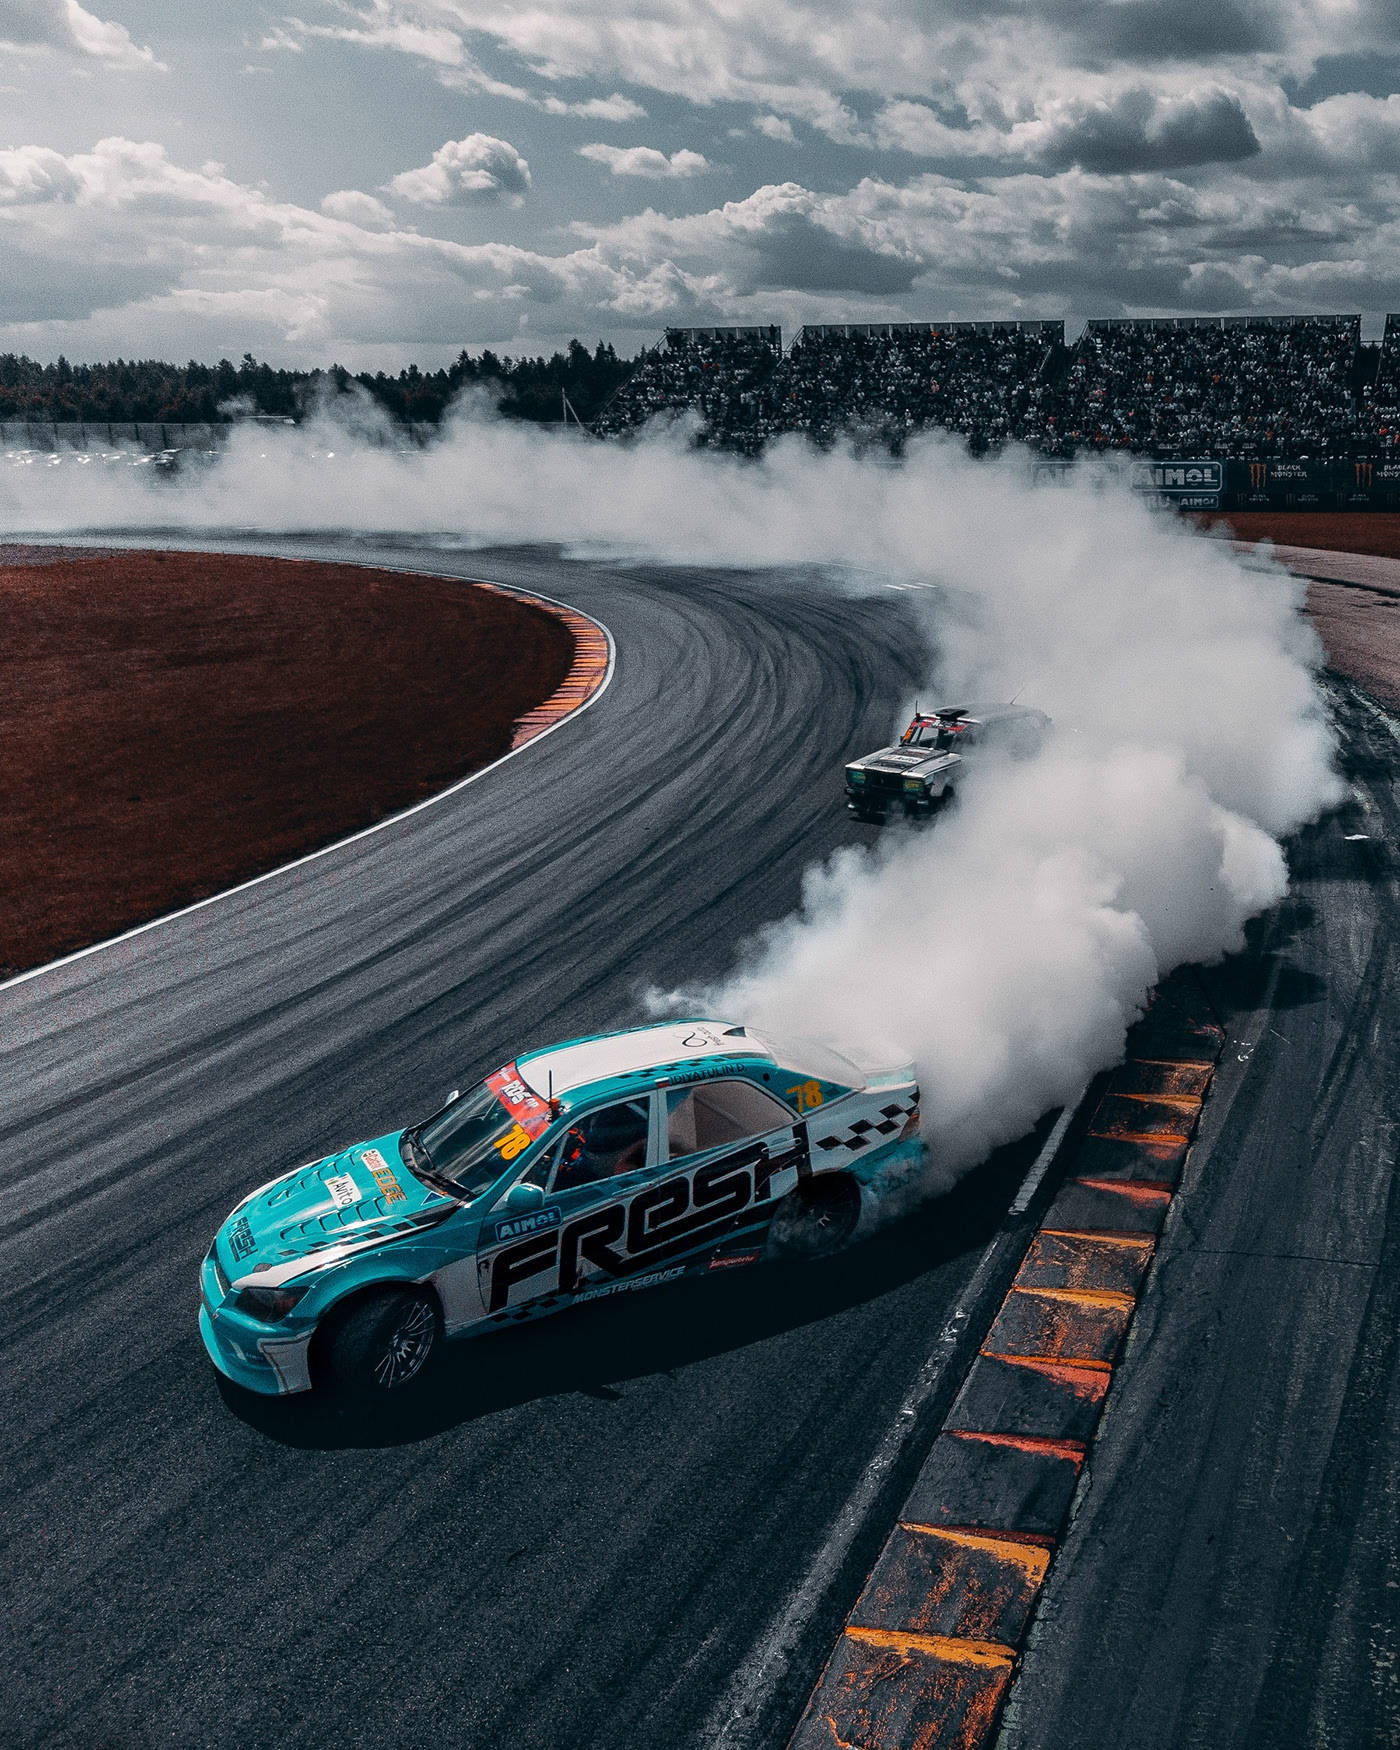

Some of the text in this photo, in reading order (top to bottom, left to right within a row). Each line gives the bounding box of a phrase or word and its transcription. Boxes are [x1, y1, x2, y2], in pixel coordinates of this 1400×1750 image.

[1138, 468, 1218, 486] AIMOL
[371, 1167, 408, 1206] EDGE
[500, 1211, 559, 1239] AIMOL
